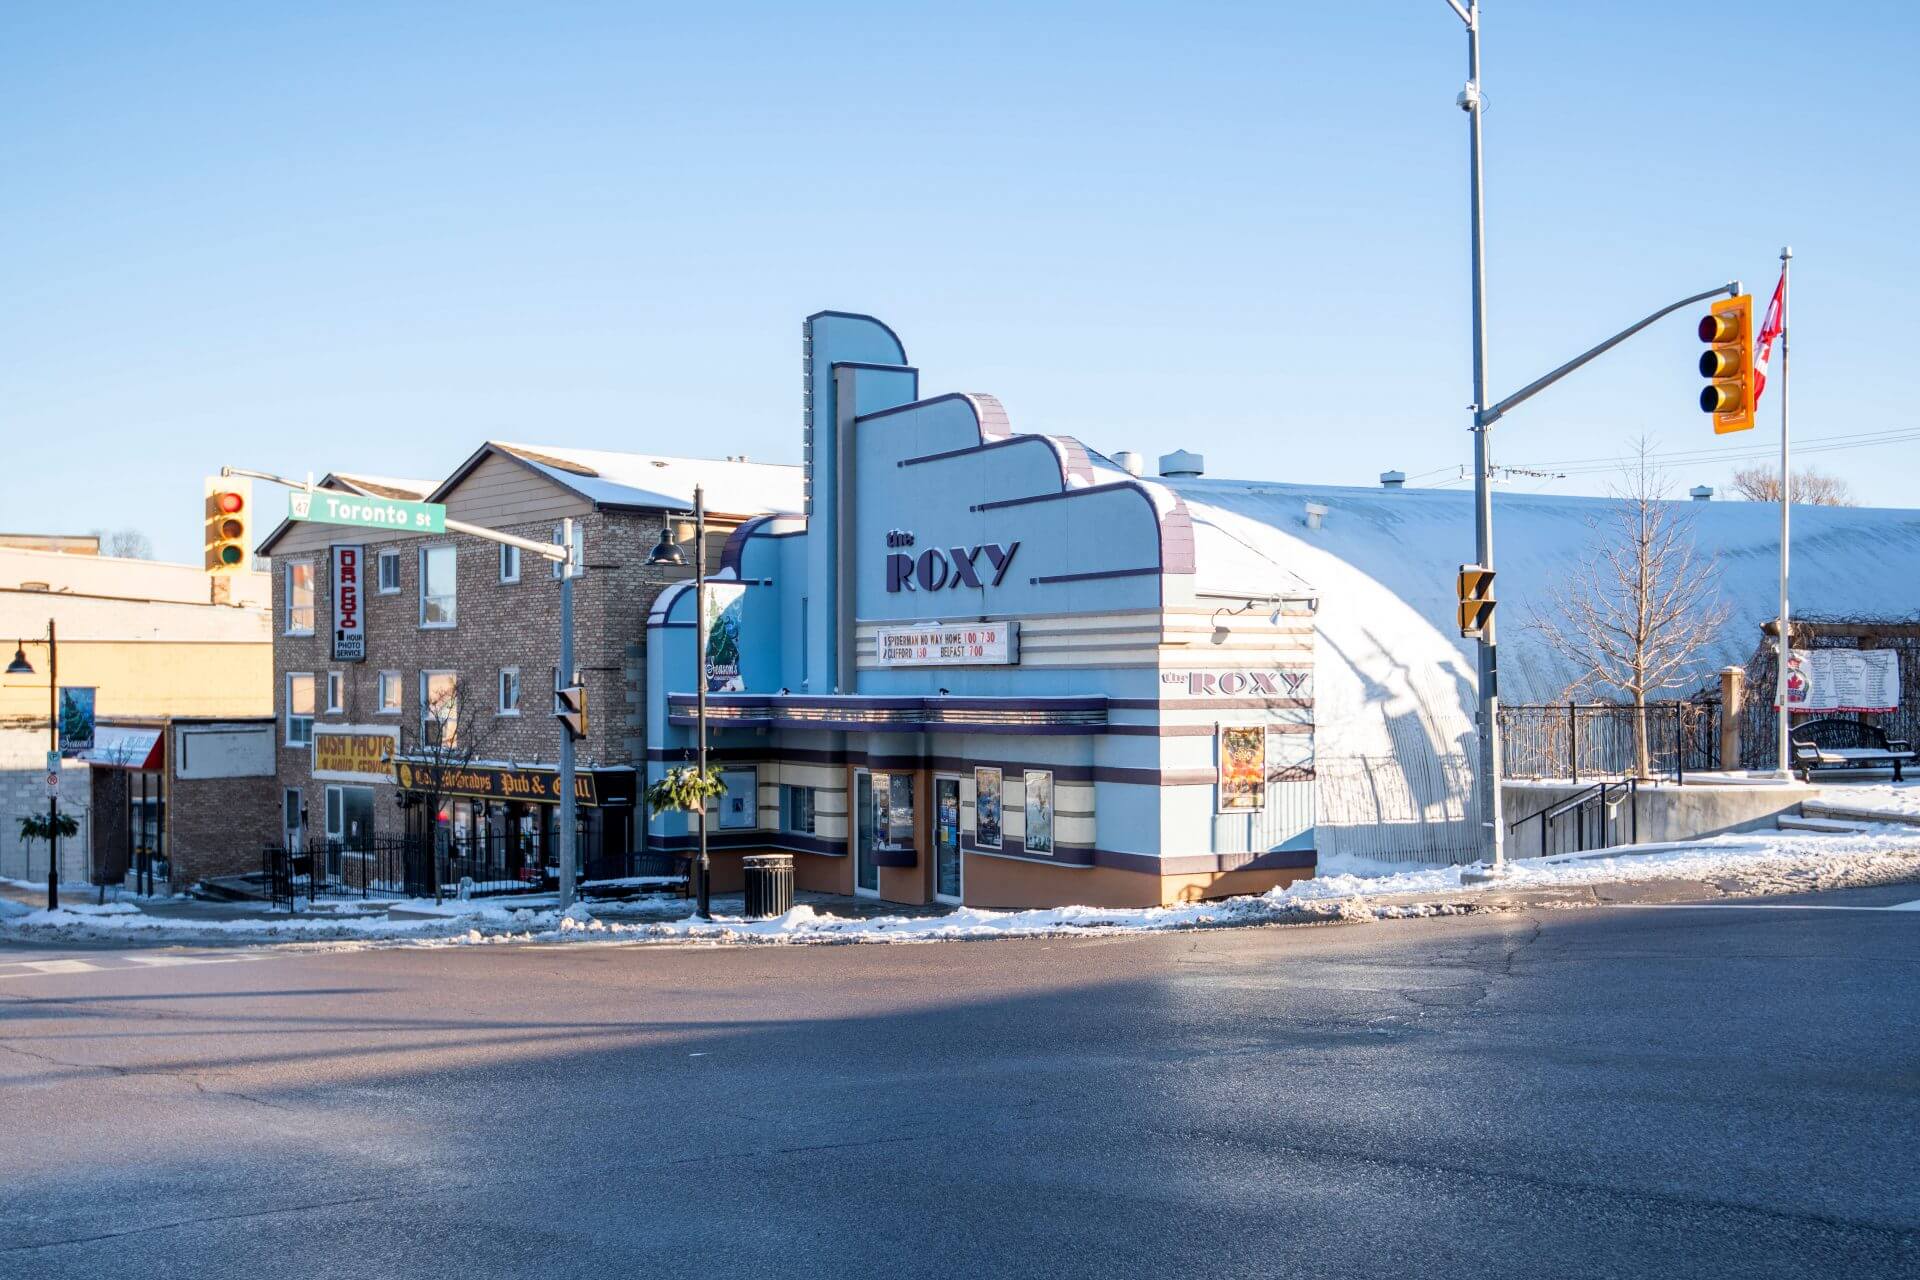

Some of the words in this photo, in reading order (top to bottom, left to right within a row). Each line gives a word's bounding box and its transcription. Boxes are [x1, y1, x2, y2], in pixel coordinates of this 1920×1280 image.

[296, 501, 308, 514] 47
[326, 499, 408, 524] Toronto
[415, 512, 431, 527] st
[886, 529, 915, 548] the
[886, 541, 1020, 592] ROXY
[336, 630, 344, 641] 1
[346, 633, 363, 642] HOUR
[887, 633, 919, 647] SPIDERMAN
[920, 634, 929, 645] NO
[930, 633, 943, 645] WAY
[945, 633, 961, 644] HOME
[336, 649, 362, 657] SERVICE
[337, 642, 361, 650] PHOTO
[887, 647, 913, 659] CLIFFORD
[940, 646, 965, 658] BELFAST
[1162, 672, 1187, 684] the
[1189, 672, 1308, 696] ROXY
[351, 736, 395, 757] PHOTO
[500, 773, 531, 796] Pub
[532, 775, 546, 795] &
[551, 777, 592, 798] Gill
